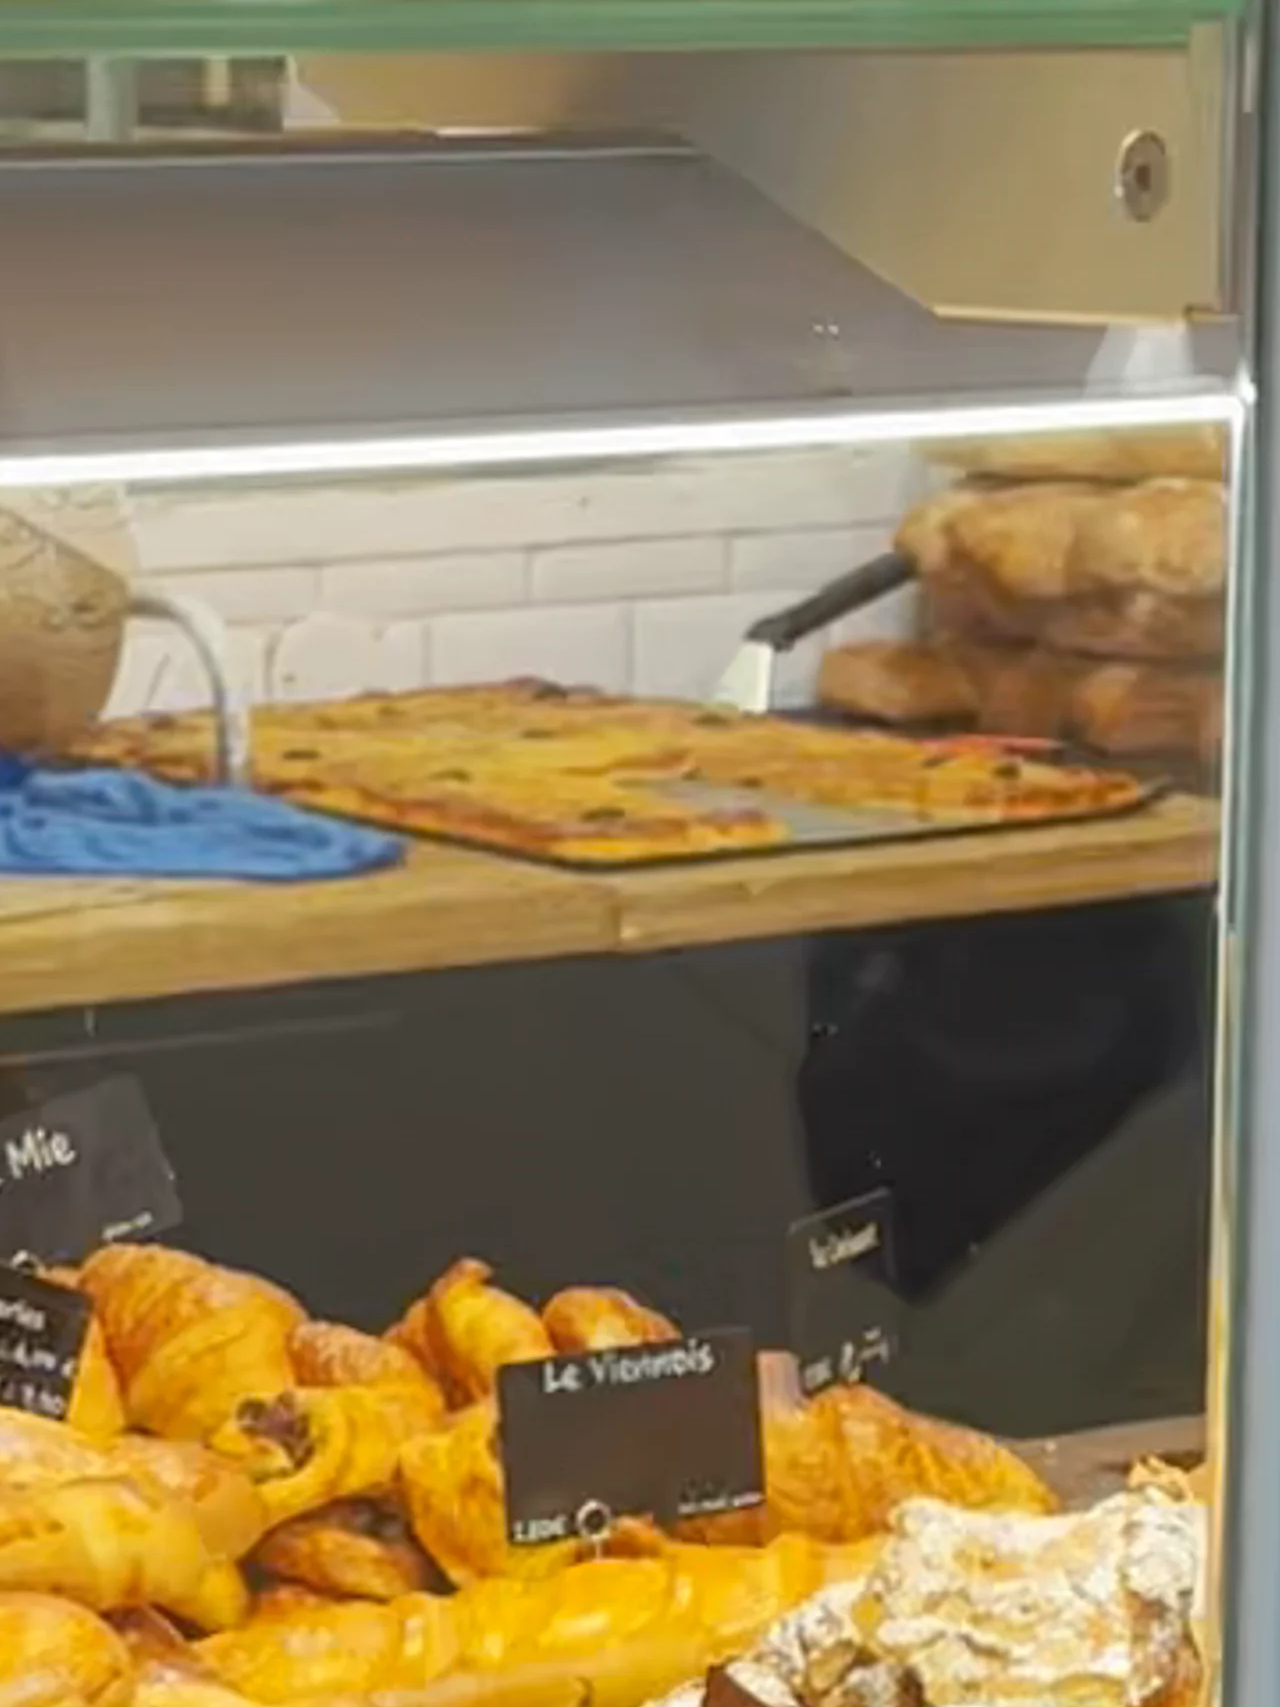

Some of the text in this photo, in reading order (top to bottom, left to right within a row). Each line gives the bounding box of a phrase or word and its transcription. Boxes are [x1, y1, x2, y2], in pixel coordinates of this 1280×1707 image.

[5, 1126, 76, 1179] Mie
[543, 1337, 715, 1393] Le Viennois
